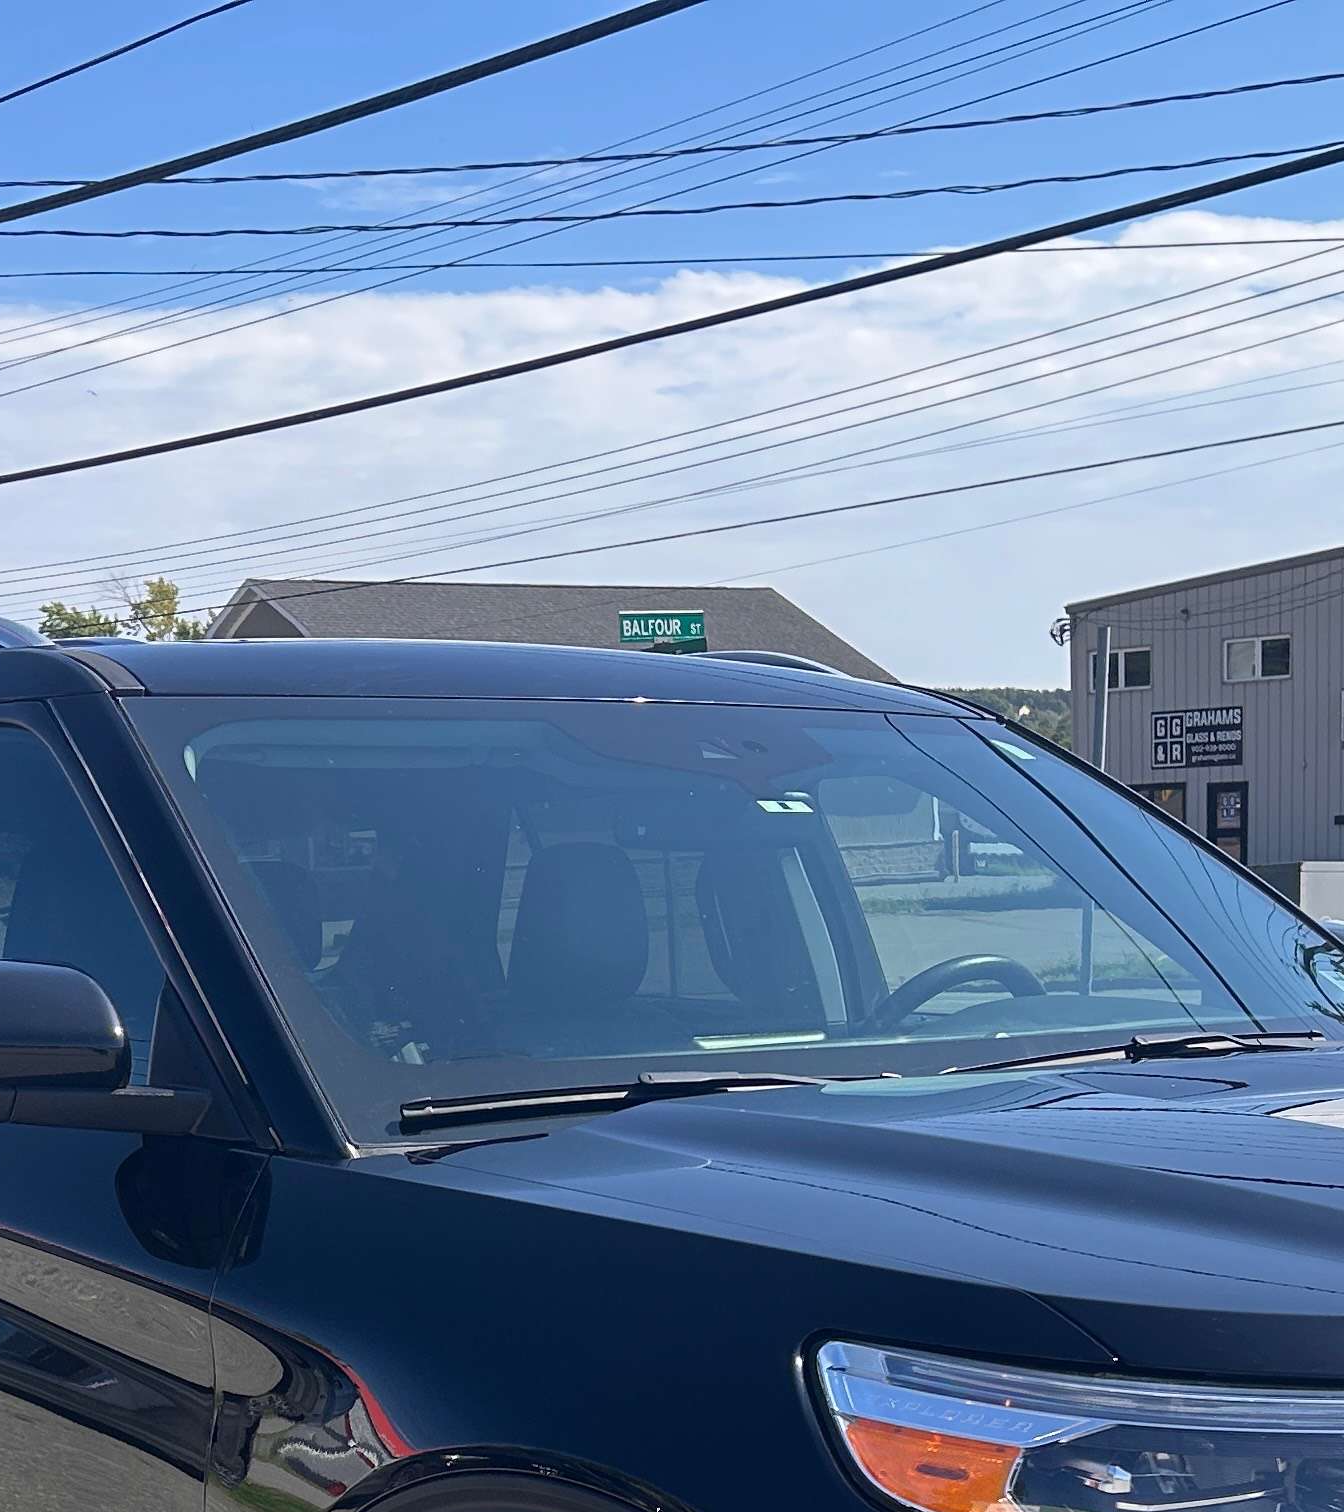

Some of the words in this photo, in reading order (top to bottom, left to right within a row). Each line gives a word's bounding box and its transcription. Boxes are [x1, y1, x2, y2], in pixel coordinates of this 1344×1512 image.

[622, 619, 682, 636] BALFOUR
[690, 623, 702, 635] ST
[1186, 709, 1241, 727] GRAHAMS
[1156, 719, 1166, 737] G
[1172, 718, 1181, 736] G
[1186, 732, 1209, 743] GLASS
[1157, 745, 1166, 761] &
[1172, 744, 1181, 760] R
[863, 1391, 1034, 1433] XPLORER
